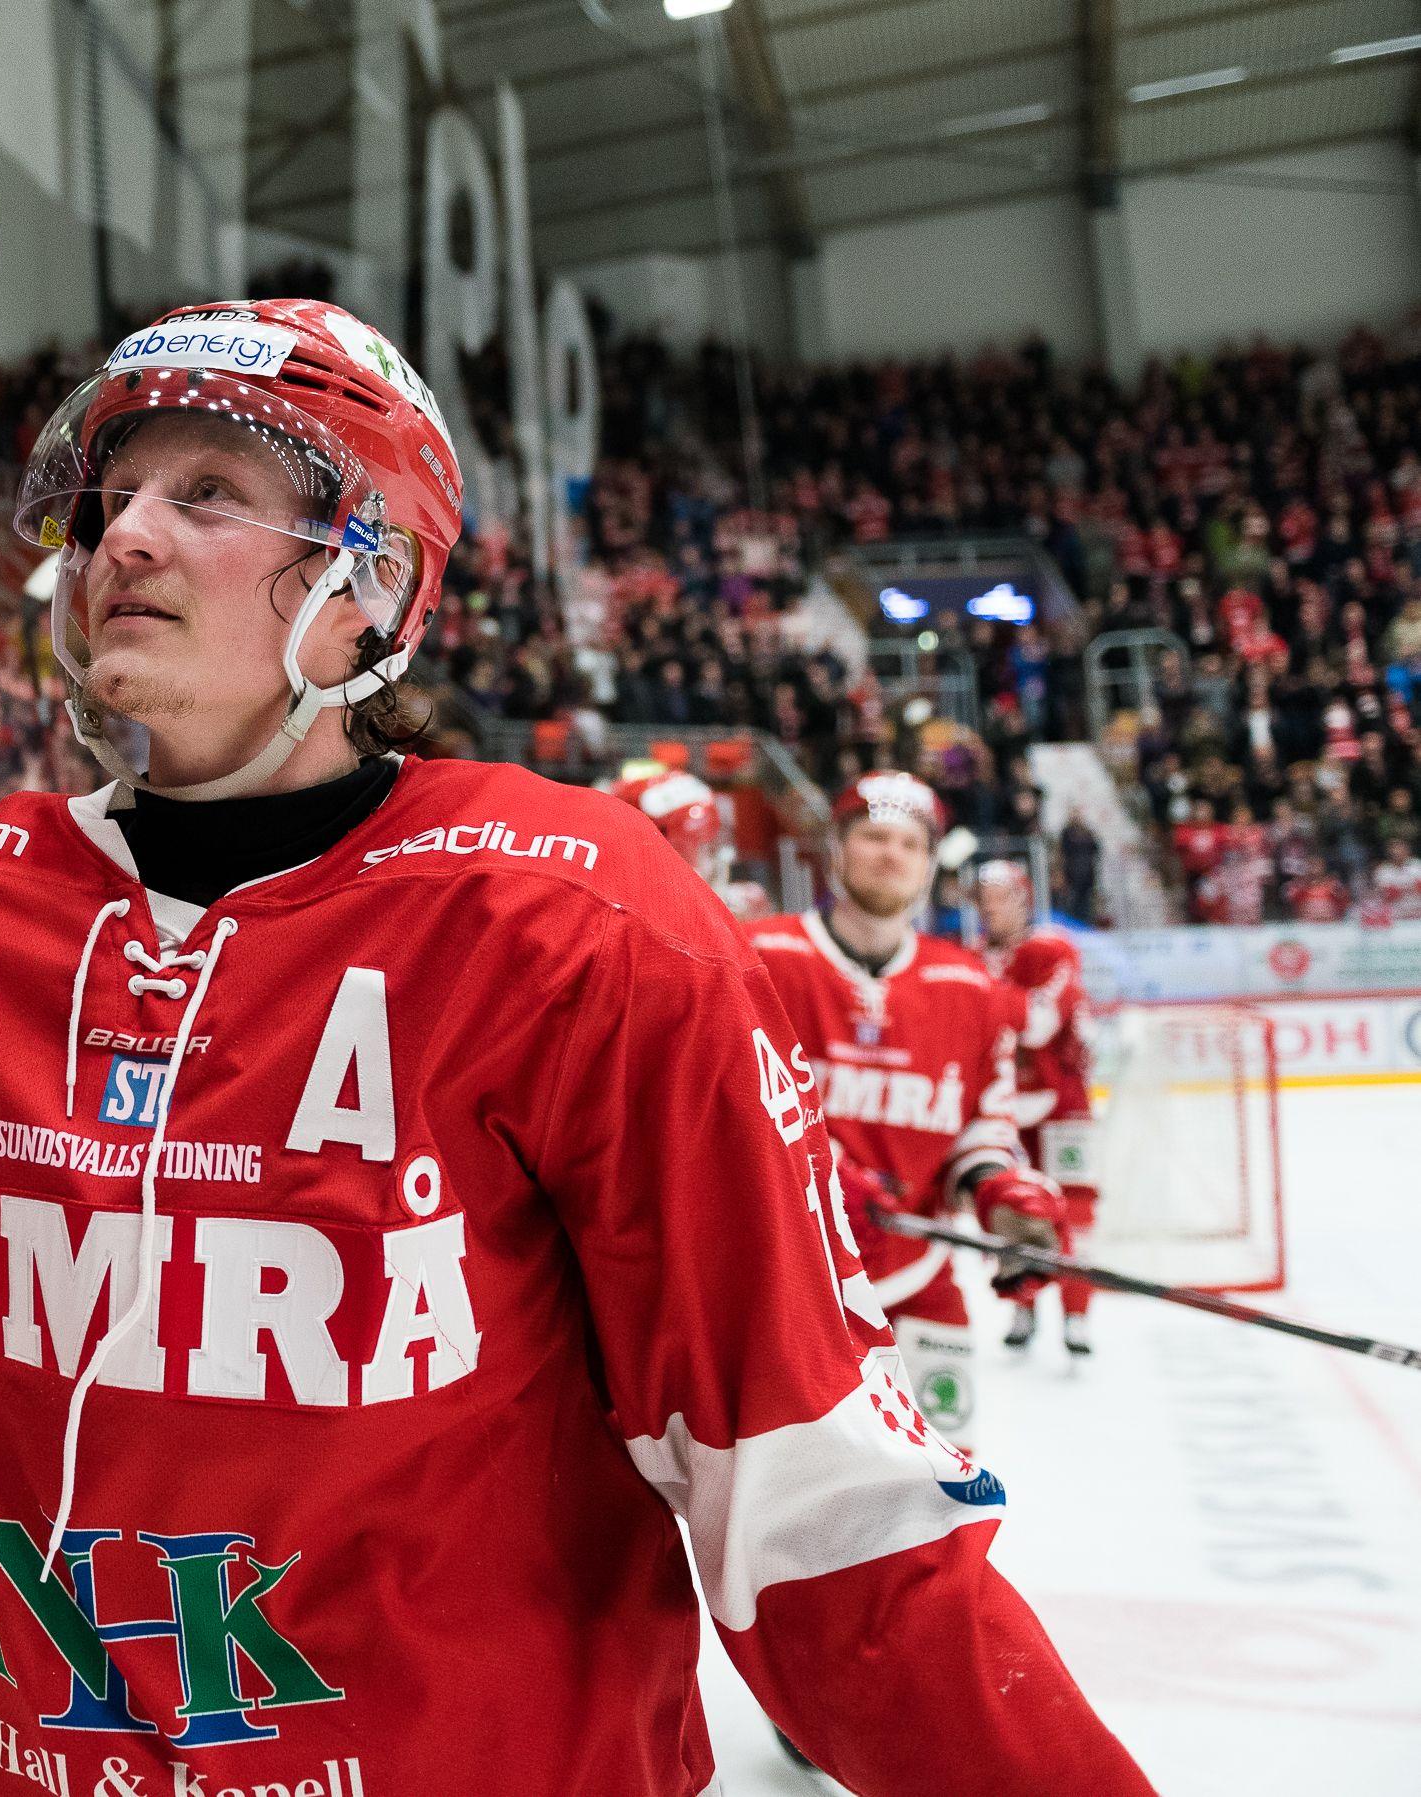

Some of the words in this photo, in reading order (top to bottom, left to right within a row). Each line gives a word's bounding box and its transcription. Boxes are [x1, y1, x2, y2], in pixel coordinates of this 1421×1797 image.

[84, 1028, 213, 1056] BAUER
[285, 966, 397, 1162] A
[106, 1060, 171, 1124] ST
